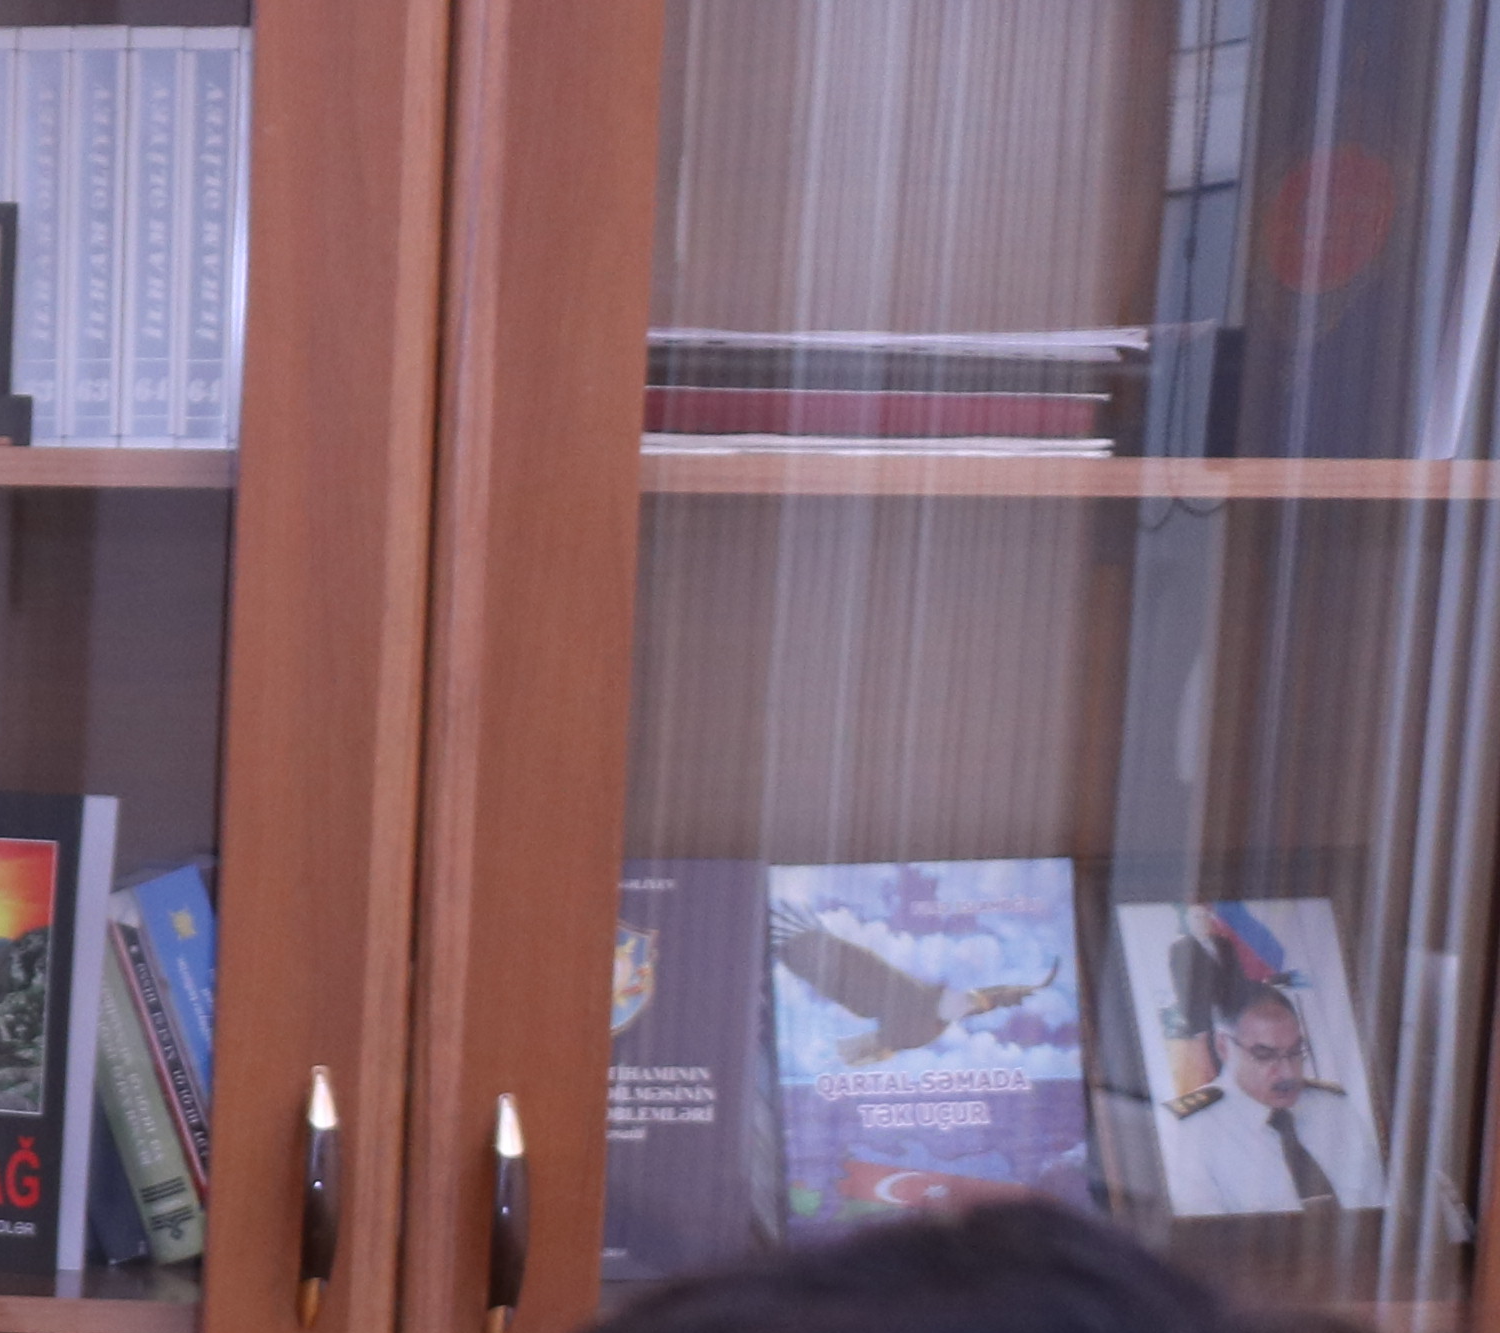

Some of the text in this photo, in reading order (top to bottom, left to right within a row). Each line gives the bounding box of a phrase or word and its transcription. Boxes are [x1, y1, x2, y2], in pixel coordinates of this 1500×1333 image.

[817, 1067, 1032, 1100] QARTAL SƏMADA
[857, 1100, 991, 1130] TƏK UÇUR
